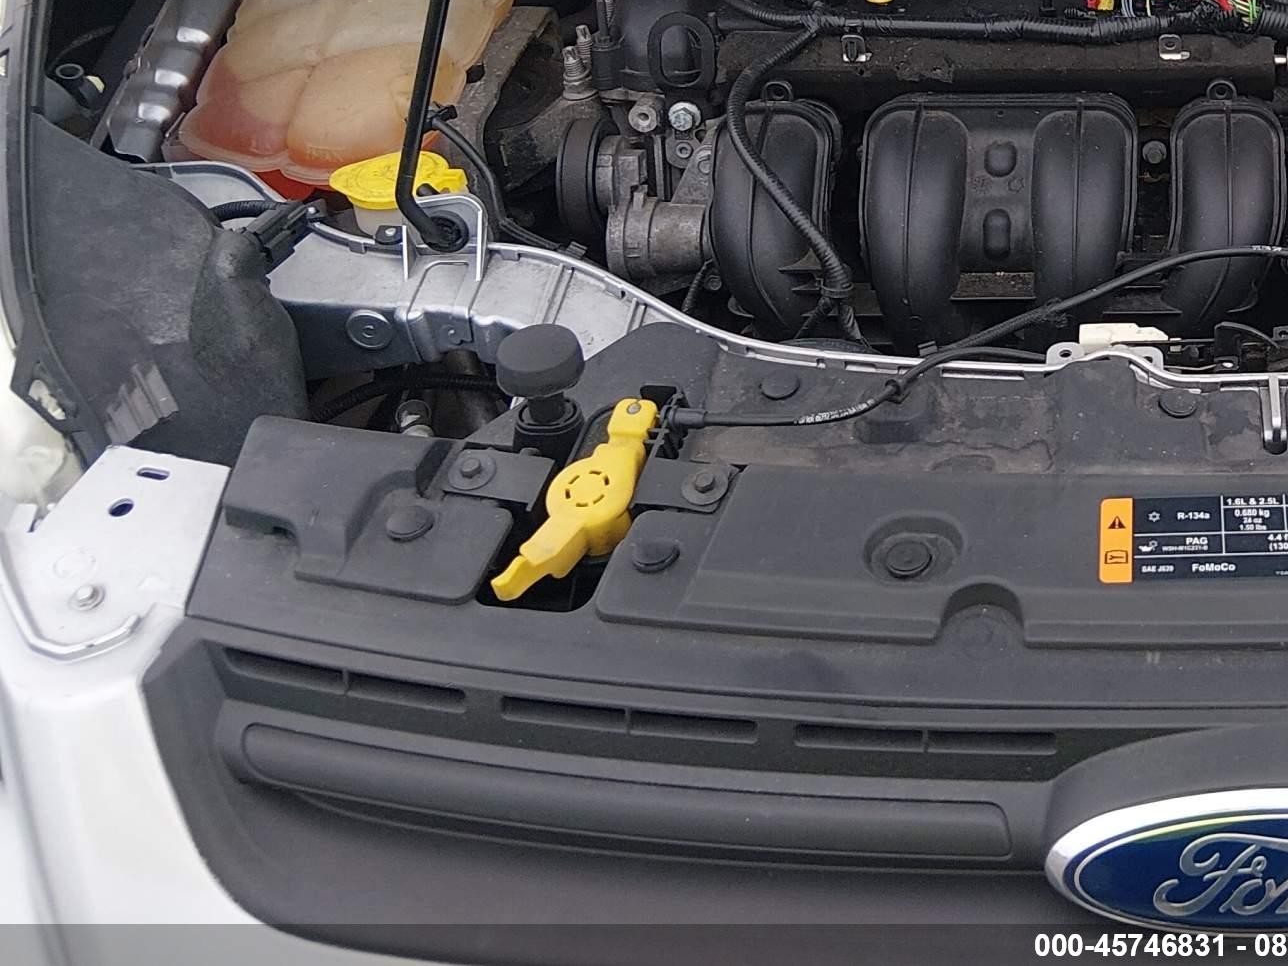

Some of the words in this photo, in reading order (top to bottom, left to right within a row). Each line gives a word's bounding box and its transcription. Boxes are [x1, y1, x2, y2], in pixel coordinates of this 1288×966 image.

[1226, 497, 1247, 506] 1.6L
[1248, 497, 1257, 505] &
[1258, 497, 1280, 505] 2.5L
[1176, 511, 1211, 520] R-134a
[1258, 508, 1271, 518] kg
[1185, 537, 1209, 545] PAG
[1267, 533, 1283, 541] 4.4
[1268, 541, 1288, 551] (130
[1191, 563, 1236, 573] FoMoCo
